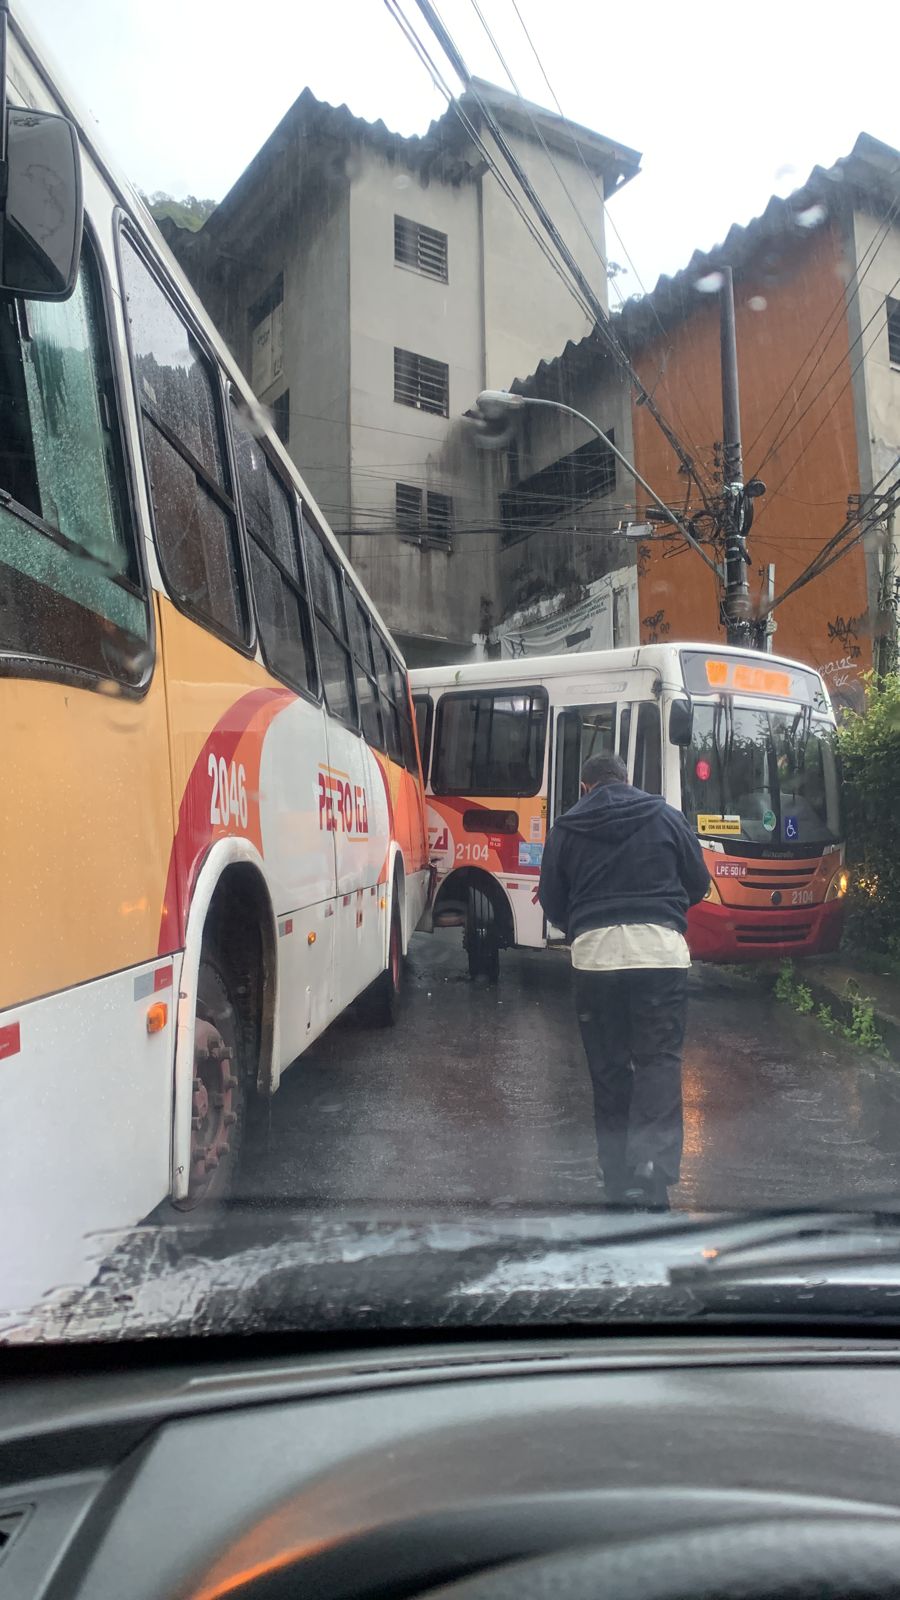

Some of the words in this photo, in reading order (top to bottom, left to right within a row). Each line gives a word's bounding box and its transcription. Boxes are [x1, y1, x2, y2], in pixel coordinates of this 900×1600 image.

[208, 752, 248, 830] 2046
[455, 843, 490, 862] 2104
[791, 890, 814, 904] 2104
